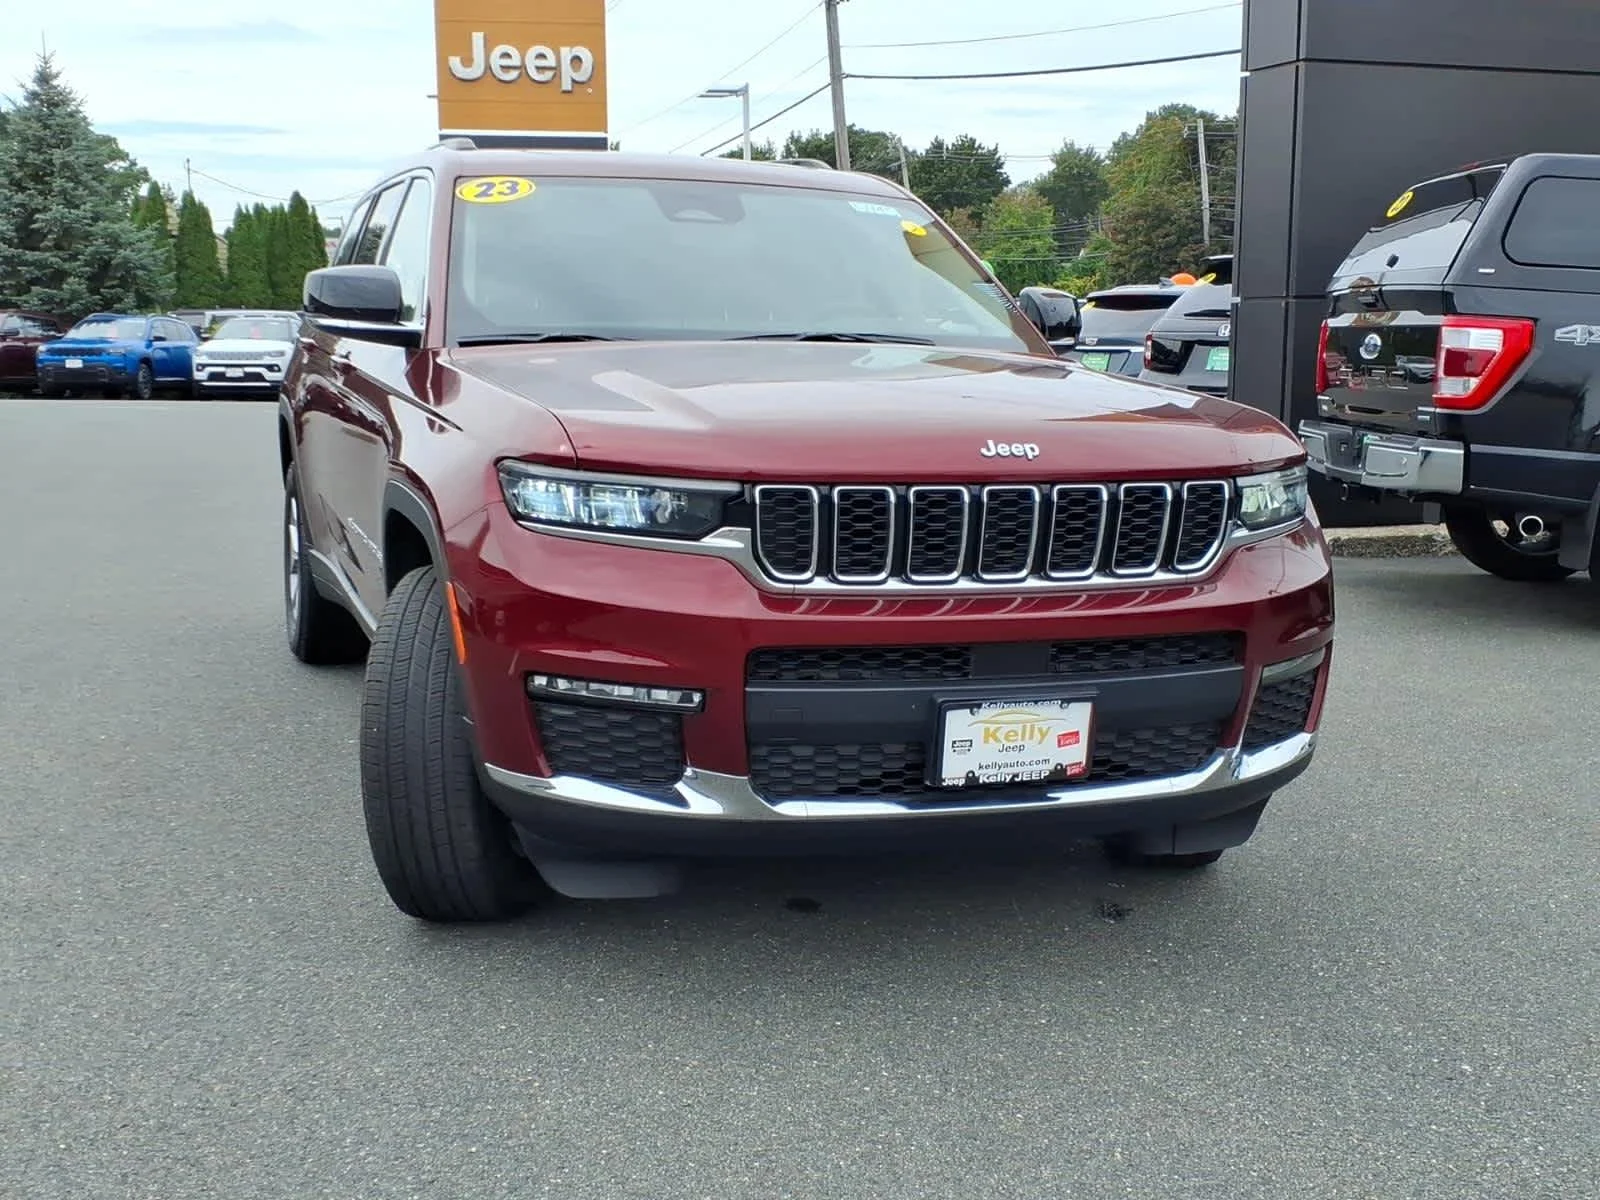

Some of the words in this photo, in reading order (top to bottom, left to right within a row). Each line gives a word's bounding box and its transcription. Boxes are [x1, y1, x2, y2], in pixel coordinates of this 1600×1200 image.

[448, 31, 594, 93] Jeep
[473, 180, 520, 199] 23
[980, 439, 1040, 460] Jeep
[982, 723, 1051, 745] Kelly
[997, 743, 1026, 753] Jeep
[978, 758, 1051, 771] kellyauto.com
[979, 773, 1013, 784] Kelly
[1014, 770, 1050, 781] JEEP
